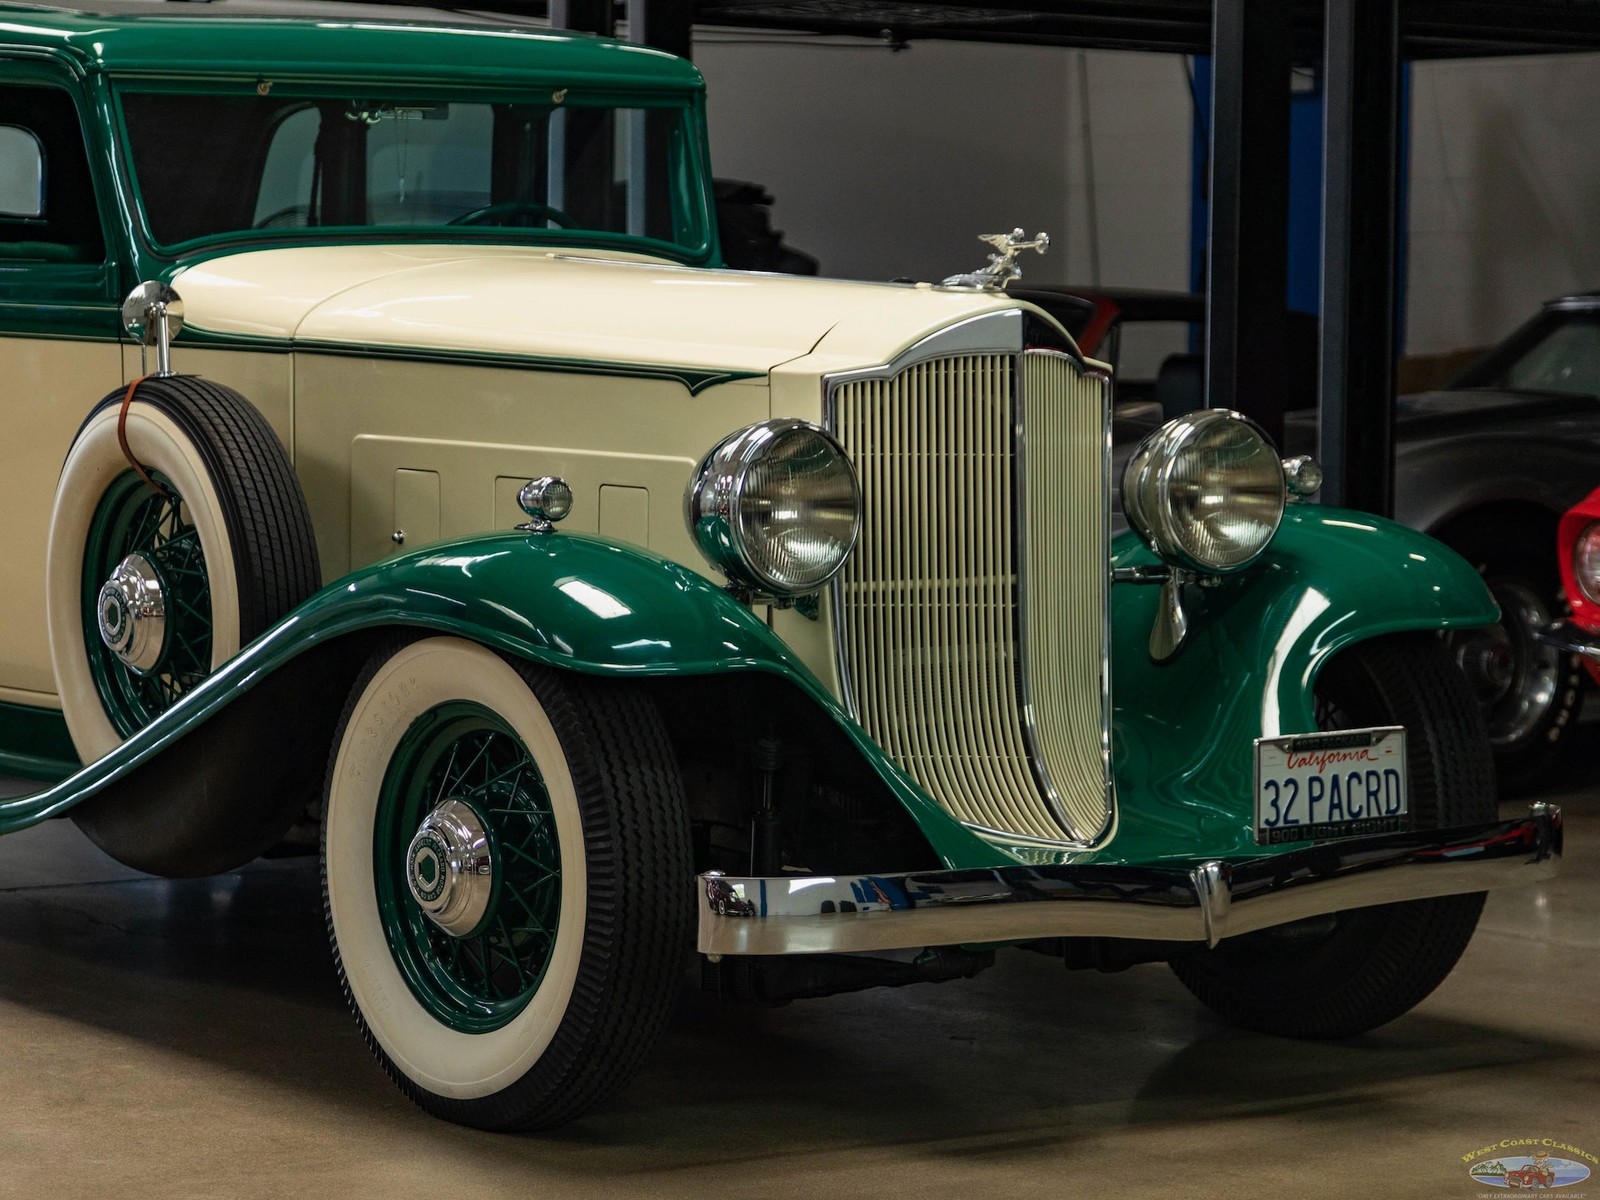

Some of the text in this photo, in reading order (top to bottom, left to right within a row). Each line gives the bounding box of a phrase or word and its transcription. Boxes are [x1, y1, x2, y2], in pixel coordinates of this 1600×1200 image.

[1287, 748, 1379, 774] California
[1264, 768, 1400, 827] 32 PACRD
[1272, 828, 1298, 843] 900
